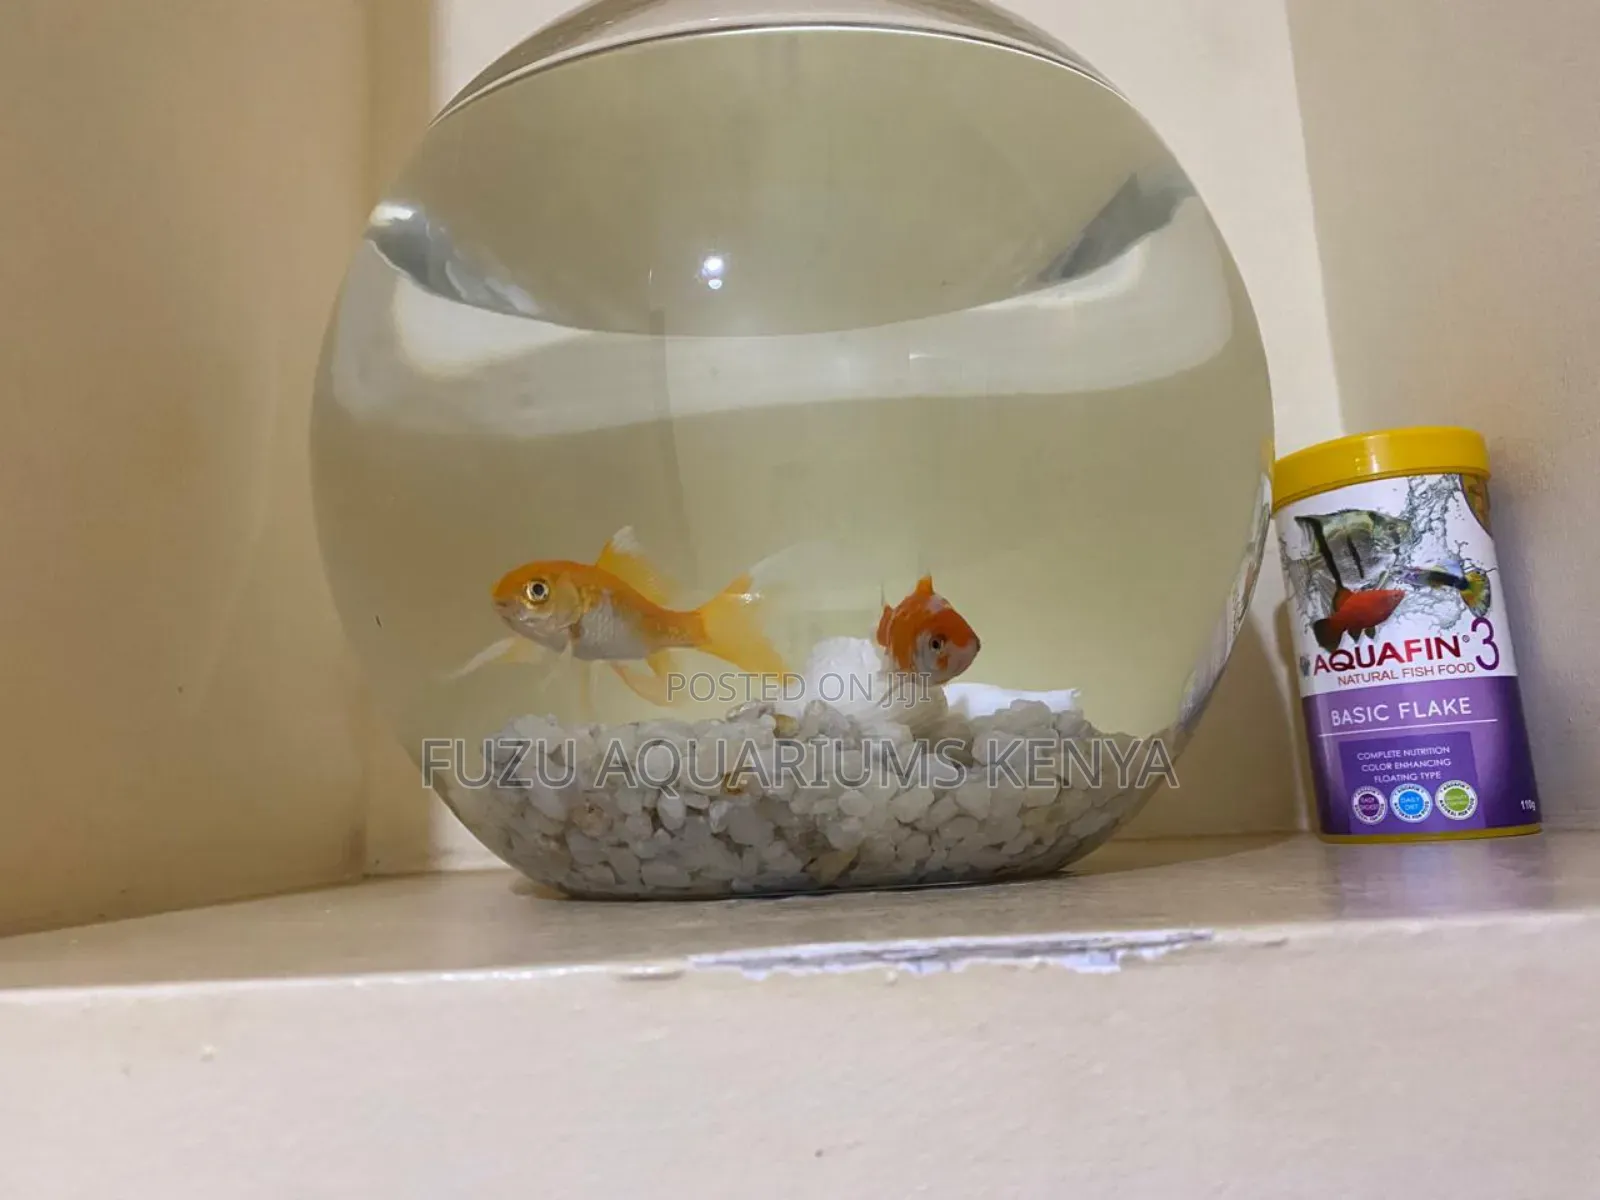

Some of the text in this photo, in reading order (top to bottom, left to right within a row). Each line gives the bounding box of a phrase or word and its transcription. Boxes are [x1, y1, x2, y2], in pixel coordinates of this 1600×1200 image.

[1471, 616, 1500, 670] 3
[1337, 662, 1476, 687] NATURAL FISH FOOD
[1331, 697, 1473, 727] BASIC FLAKE
[1357, 746, 1451, 761] COMPLETE NUTRITION
[1361, 758, 1452, 772] COLOR ENHANCING
[1374, 771, 1441, 783] FLOATING TYPE
